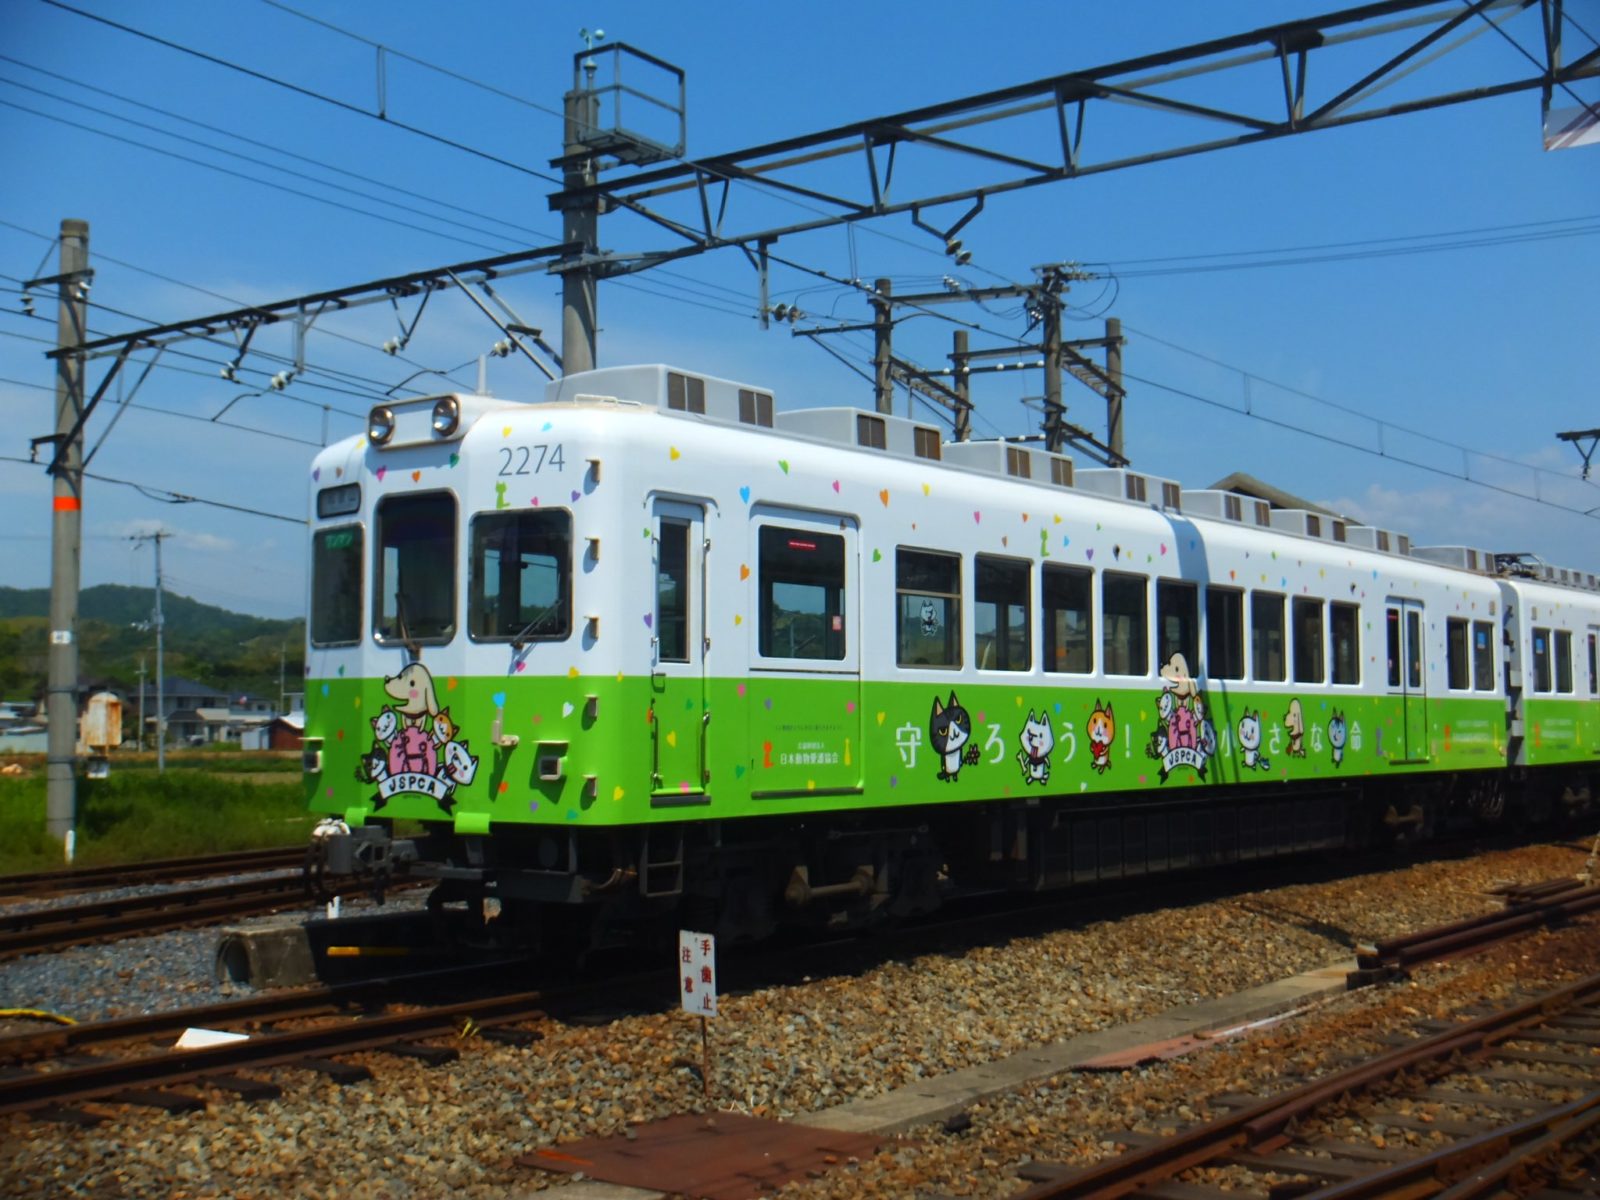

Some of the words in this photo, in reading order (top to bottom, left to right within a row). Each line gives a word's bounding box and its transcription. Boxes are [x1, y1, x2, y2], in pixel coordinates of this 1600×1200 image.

[498, 443, 565, 477] 2274
[1169, 748, 1197, 766] JSPCA
[389, 775, 436, 794] JSPCA
